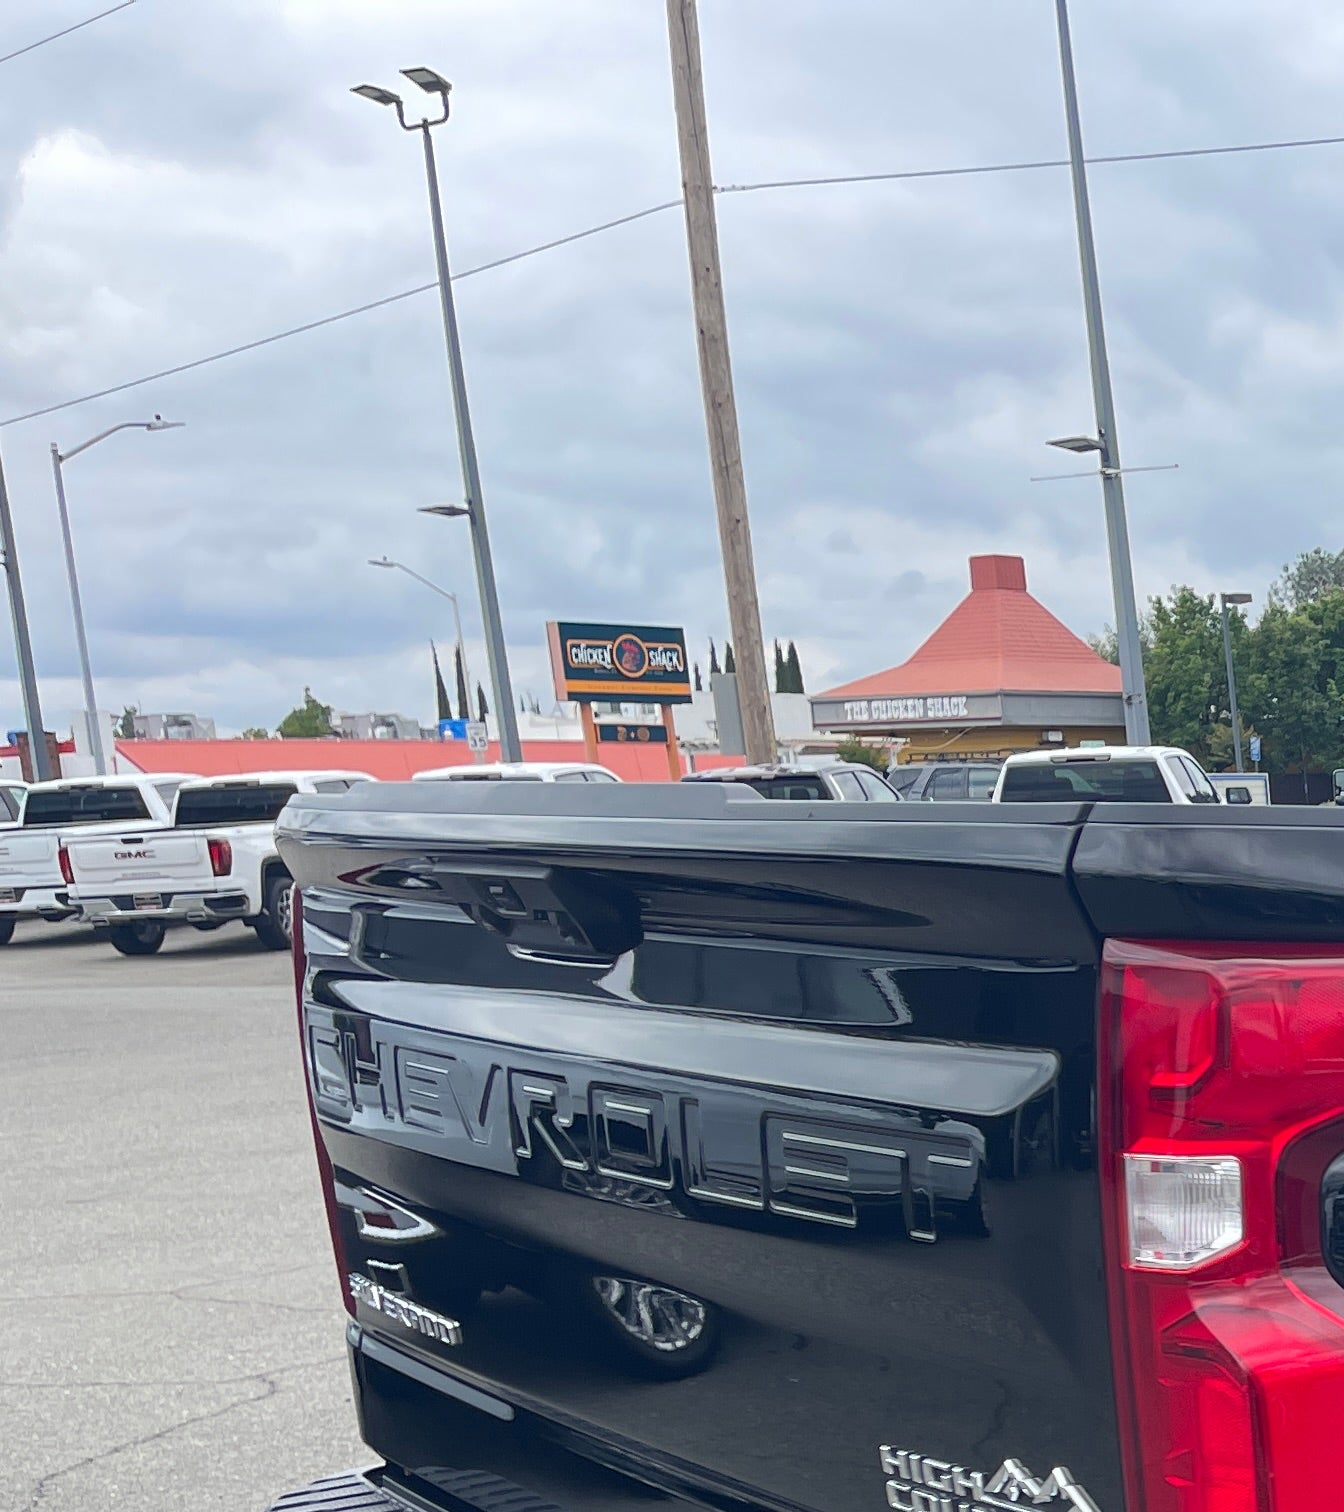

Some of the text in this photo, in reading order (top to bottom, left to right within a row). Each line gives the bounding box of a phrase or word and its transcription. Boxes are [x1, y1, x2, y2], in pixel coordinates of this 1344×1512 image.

[571, 643, 683, 672] CHICKEN SHACK
[844, 696, 968, 721] THE CHICKEN SHACK
[114, 850, 156, 860] GMC
[308, 1024, 980, 1242] CHEVROLET
[879, 1444, 984, 1502] HIGH
